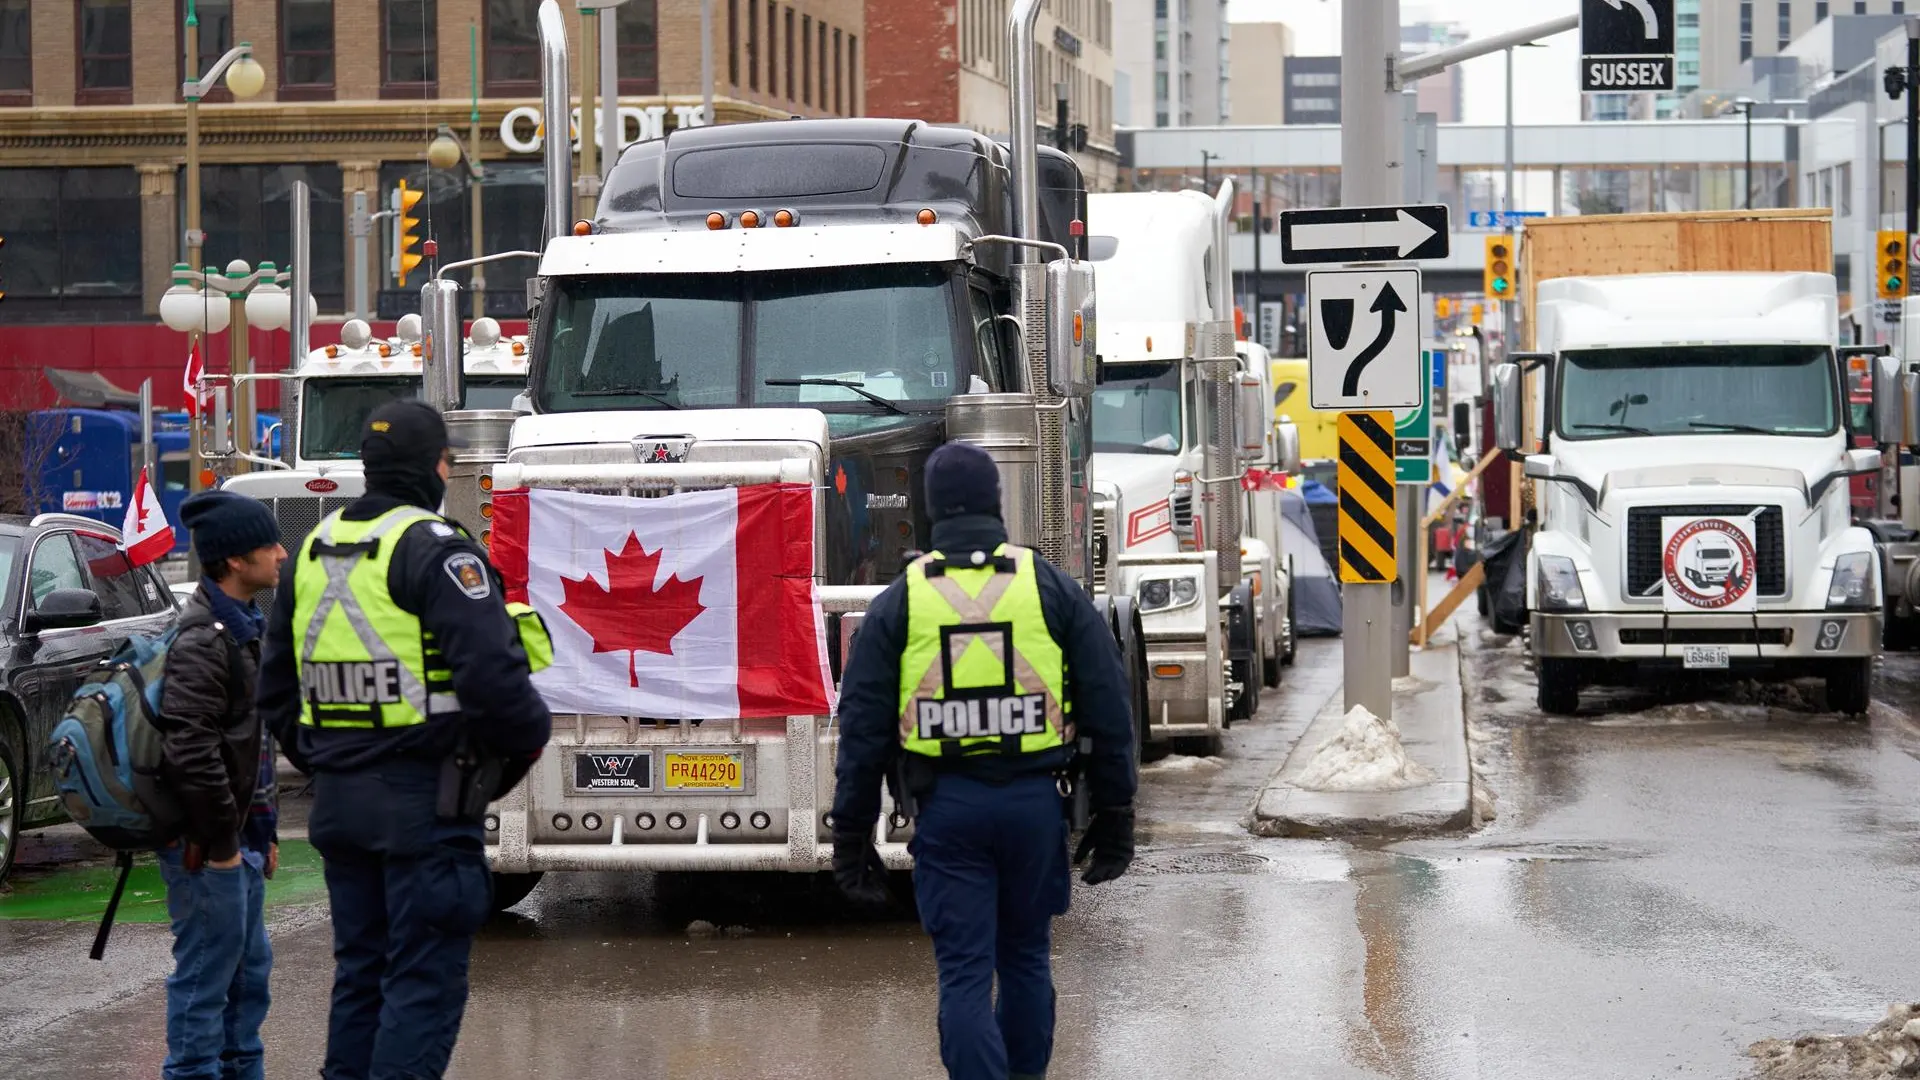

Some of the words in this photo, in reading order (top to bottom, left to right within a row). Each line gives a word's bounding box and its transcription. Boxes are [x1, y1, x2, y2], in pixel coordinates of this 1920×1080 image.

[1590, 62, 1665, 86] SUSSEX
[500, 105, 715, 153] CDU
[302, 661, 400, 703] POLICE
[919, 695, 1043, 738] POLICE
[591, 778, 619, 786] WESTERN
[620, 778, 635, 786] STAR
